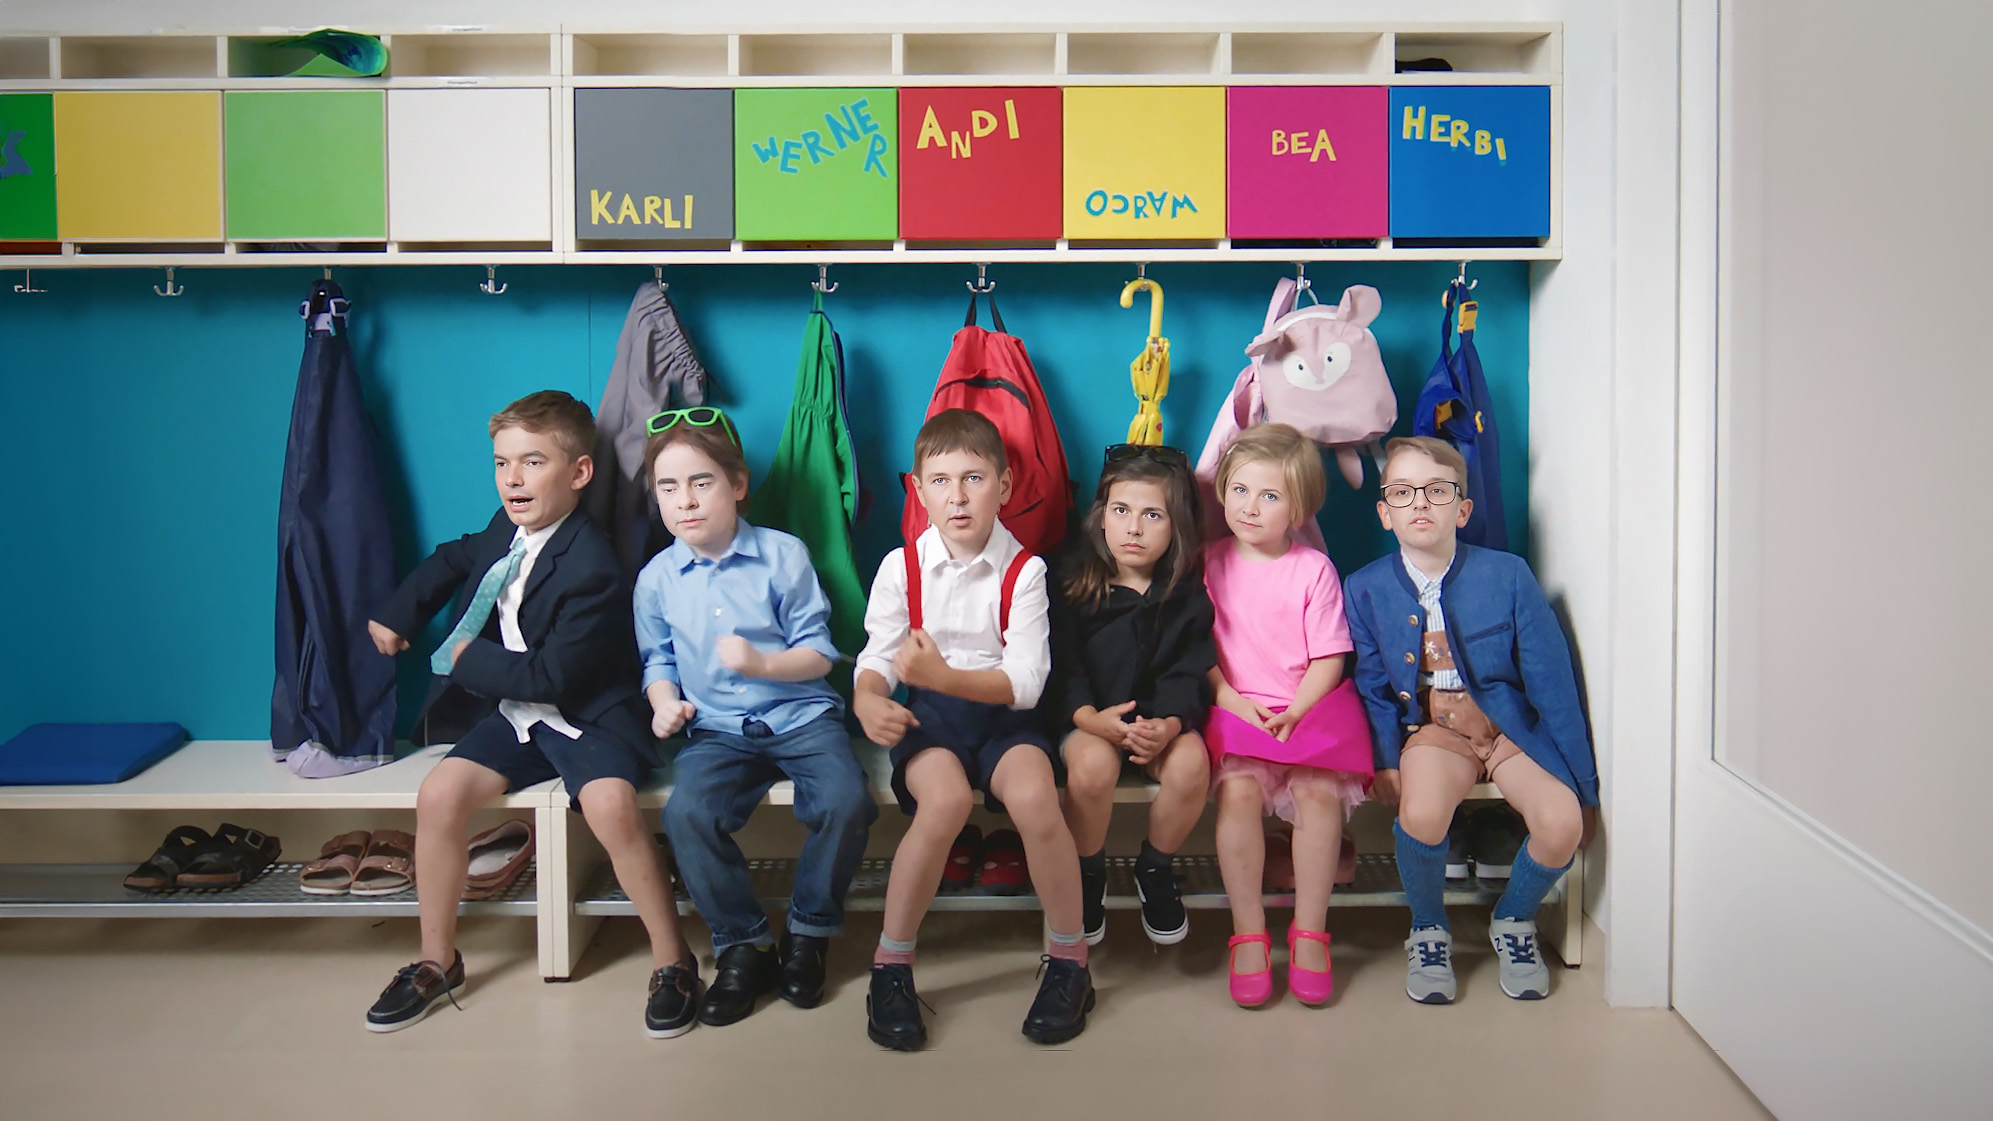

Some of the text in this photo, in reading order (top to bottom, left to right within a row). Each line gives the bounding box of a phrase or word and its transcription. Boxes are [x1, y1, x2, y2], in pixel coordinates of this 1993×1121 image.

[752, 98, 888, 177] WERNER
[916, 99, 1020, 159] ANDI
[1271, 128, 1337, 163] BEA
[1402, 105, 1508, 162] HERBI
[590, 189, 694, 229] KARLI
